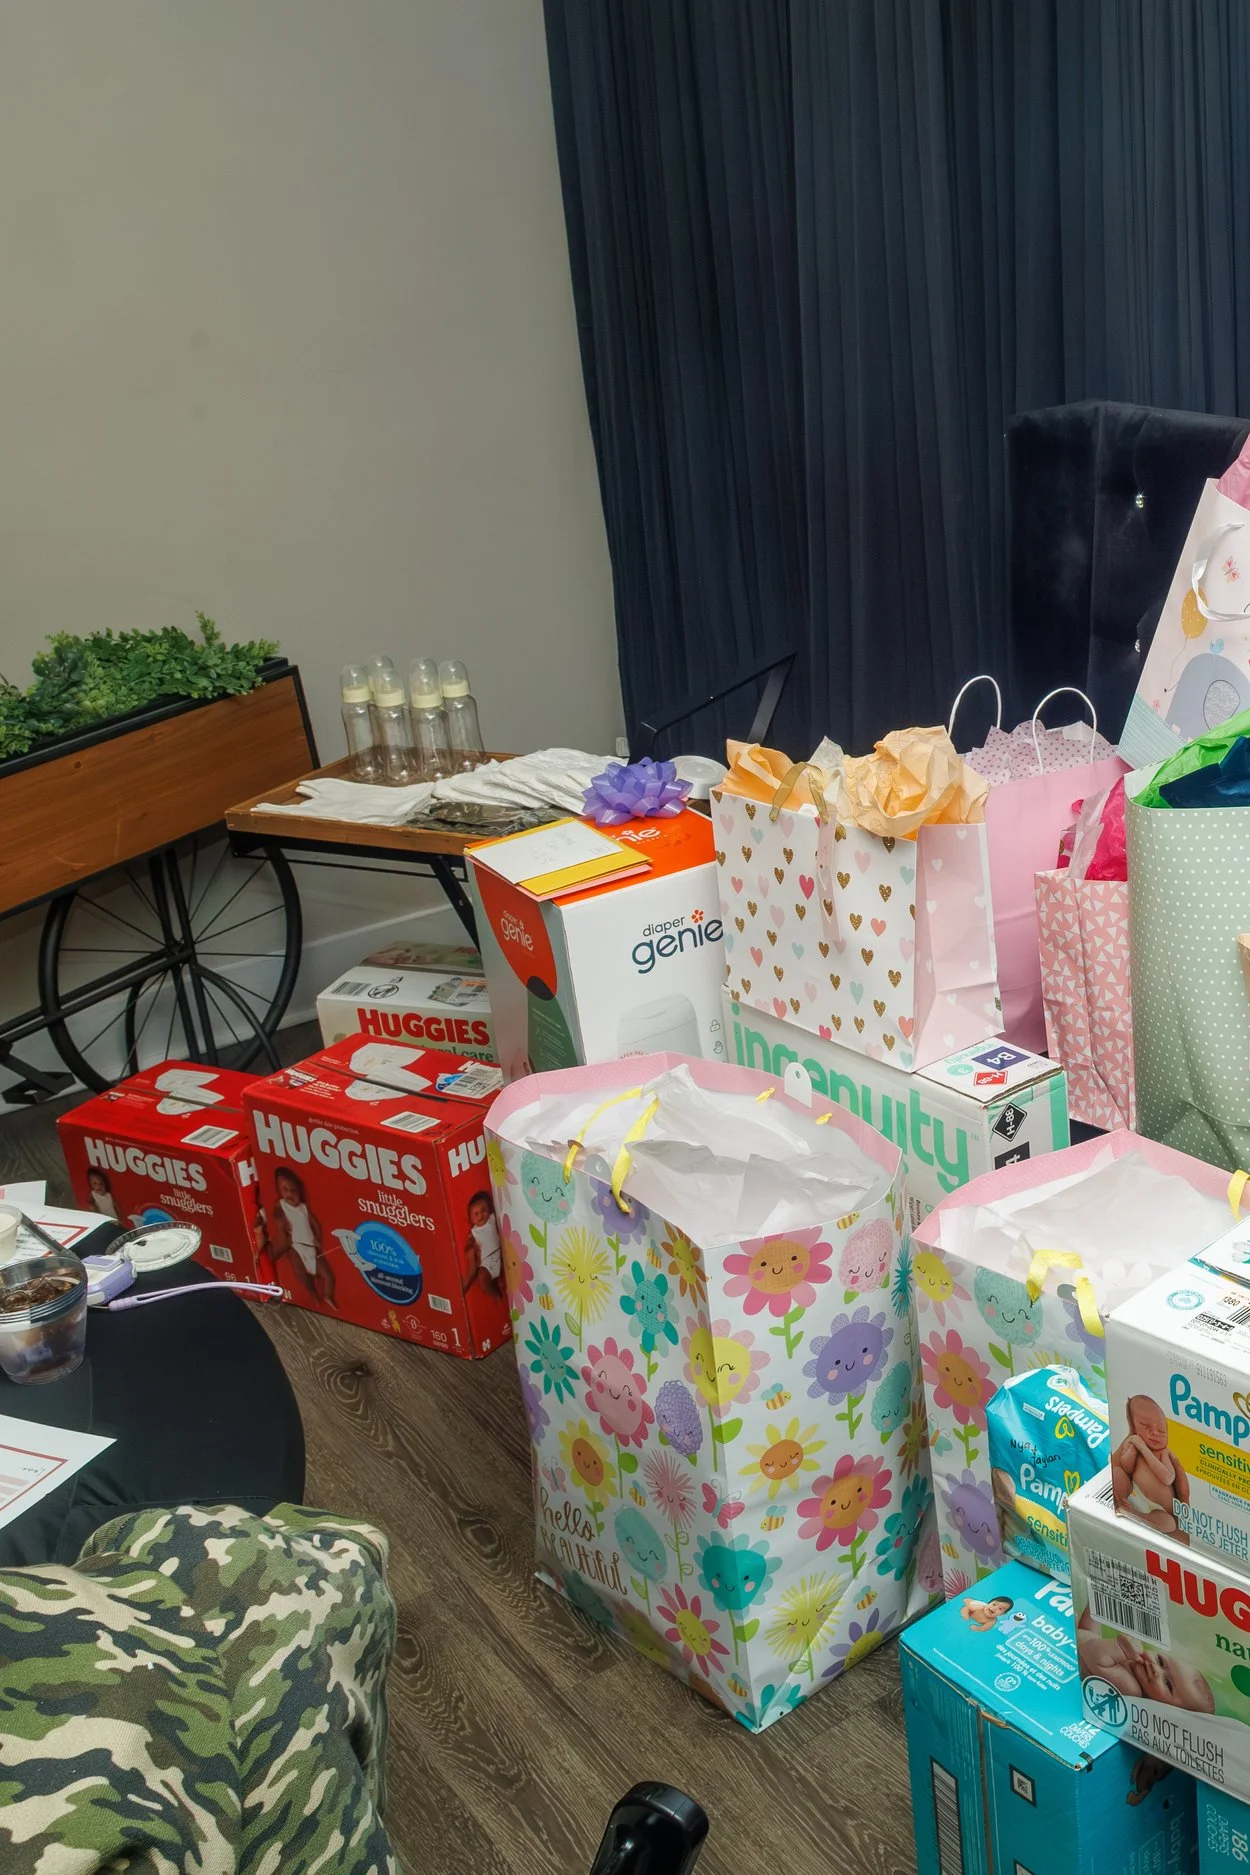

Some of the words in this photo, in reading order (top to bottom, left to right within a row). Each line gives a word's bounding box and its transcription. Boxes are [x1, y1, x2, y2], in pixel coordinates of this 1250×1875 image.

[500, 917, 534, 951] genie
[631, 916, 724, 974] genie
[643, 916, 685, 938] diaper
[357, 1007, 490, 1046] HUGGIES
[985, 1051, 1017, 1066] B4
[1004, 1107, 1016, 1137] H-88
[84, 1136, 208, 1192] HUGGIES
[252, 1109, 427, 1196] HUGGIES
[160, 1193, 214, 1216] snugglers
[173, 1188, 191, 1199] little
[378, 1189, 403, 1208] little
[358, 1197, 435, 1232] snugglers
[430, 1329, 448, 1343] 160
[451, 1327, 461, 1348] 1
[1044, 1396, 1110, 1449] Pampers
[1199, 1459, 1237, 1480] CLINICALLY
[1231, 1483, 1240, 1491] EN
[1019, 1463, 1070, 1515] Pamp
[540, 1486, 595, 1542] hello
[1027, 1514, 1069, 1548] sensiti
[1172, 1499, 1190, 1518] DO
[1192, 1507, 1213, 1530] NOT
[1215, 1517, 1248, 1548] FLUSH
[1179, 1519, 1193, 1534] NE
[1196, 1526, 1216, 1545] PAS
[1218, 1535, 1249, 1561] JETER
[1031, 1614, 1077, 1647] baby-
[1015, 1641, 1034, 1656] days
[1040, 1658, 1065, 1677] nights
[1059, 1726, 1090, 1749] COUCHES
[1131, 1703, 1149, 1729] DO
[1153, 1714, 1179, 1740] NOT
[1182, 1728, 1225, 1767] FLUSH
[1131, 1726, 1150, 1746] PAS
[1150, 1733, 1172, 1755] AUX
[1174, 1744, 1225, 1785] TOILETTES
[1206, 1803, 1218, 1853] COUCHES
[1217, 1815, 1230, 1856] DIAPERS
[1231, 1828, 1250, 1864] 186
